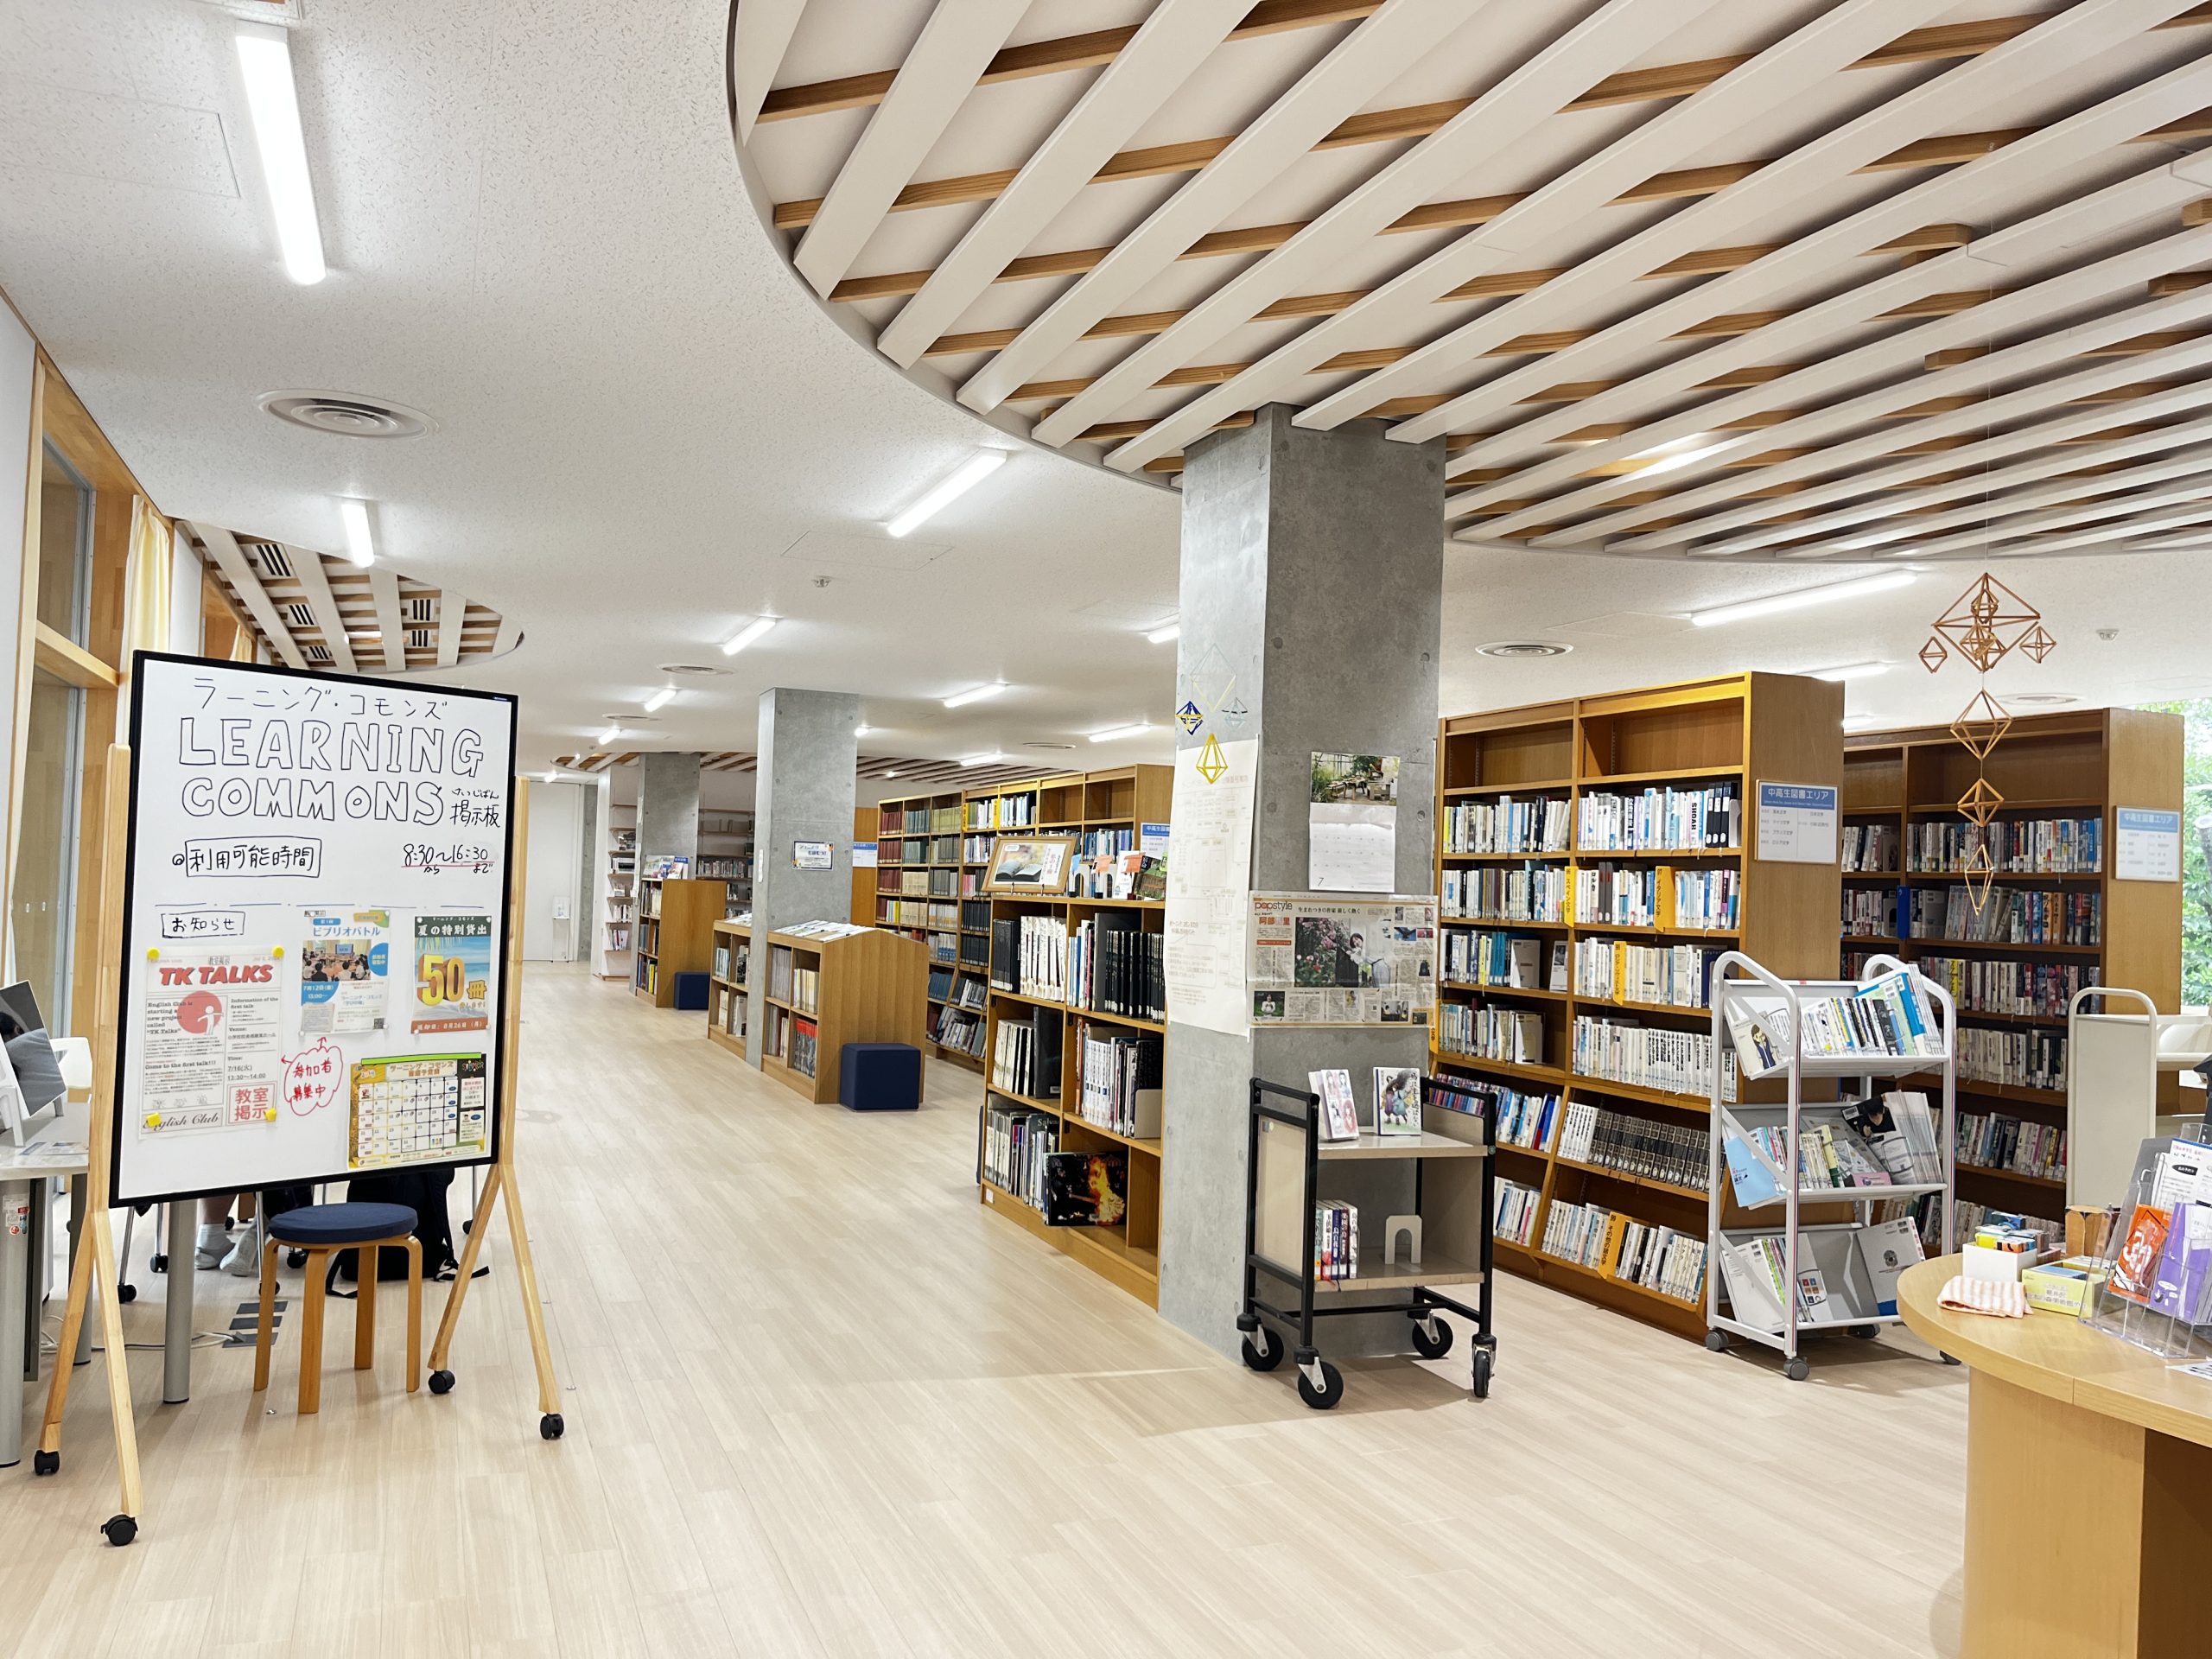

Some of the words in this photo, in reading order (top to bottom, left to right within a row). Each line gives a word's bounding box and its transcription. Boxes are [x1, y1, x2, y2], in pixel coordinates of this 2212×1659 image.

[194, 677, 448, 720] ラーニング・コモンズ
[179, 717, 483, 778] LEARNING
[181, 777, 444, 825] COMMONS
[1768, 788, 1829, 800] 中高生図書エリア
[450, 800, 501, 828] 掲示板
[188, 843, 315, 872] 利用可能時間
[423, 865, 441, 874] から
[473, 863, 493, 874] まで
[1318, 877, 1324, 887] 7
[1255, 900, 1293, 912] popstyle
[172, 916, 236, 933] お知らせ
[313, 926, 380, 937] ビブリオバトル
[418, 925, 486, 936] 夏の特別貸出
[159, 967, 194, 986] TK
[198, 964, 273, 984] TALKS
[293, 1057, 332, 1078] 参加者
[236, 1087, 269, 1104] 教室
[235, 1104, 267, 1122] 掲示
[143, 1114, 187, 1132] glish
[192, 1112, 218, 1124] Club
